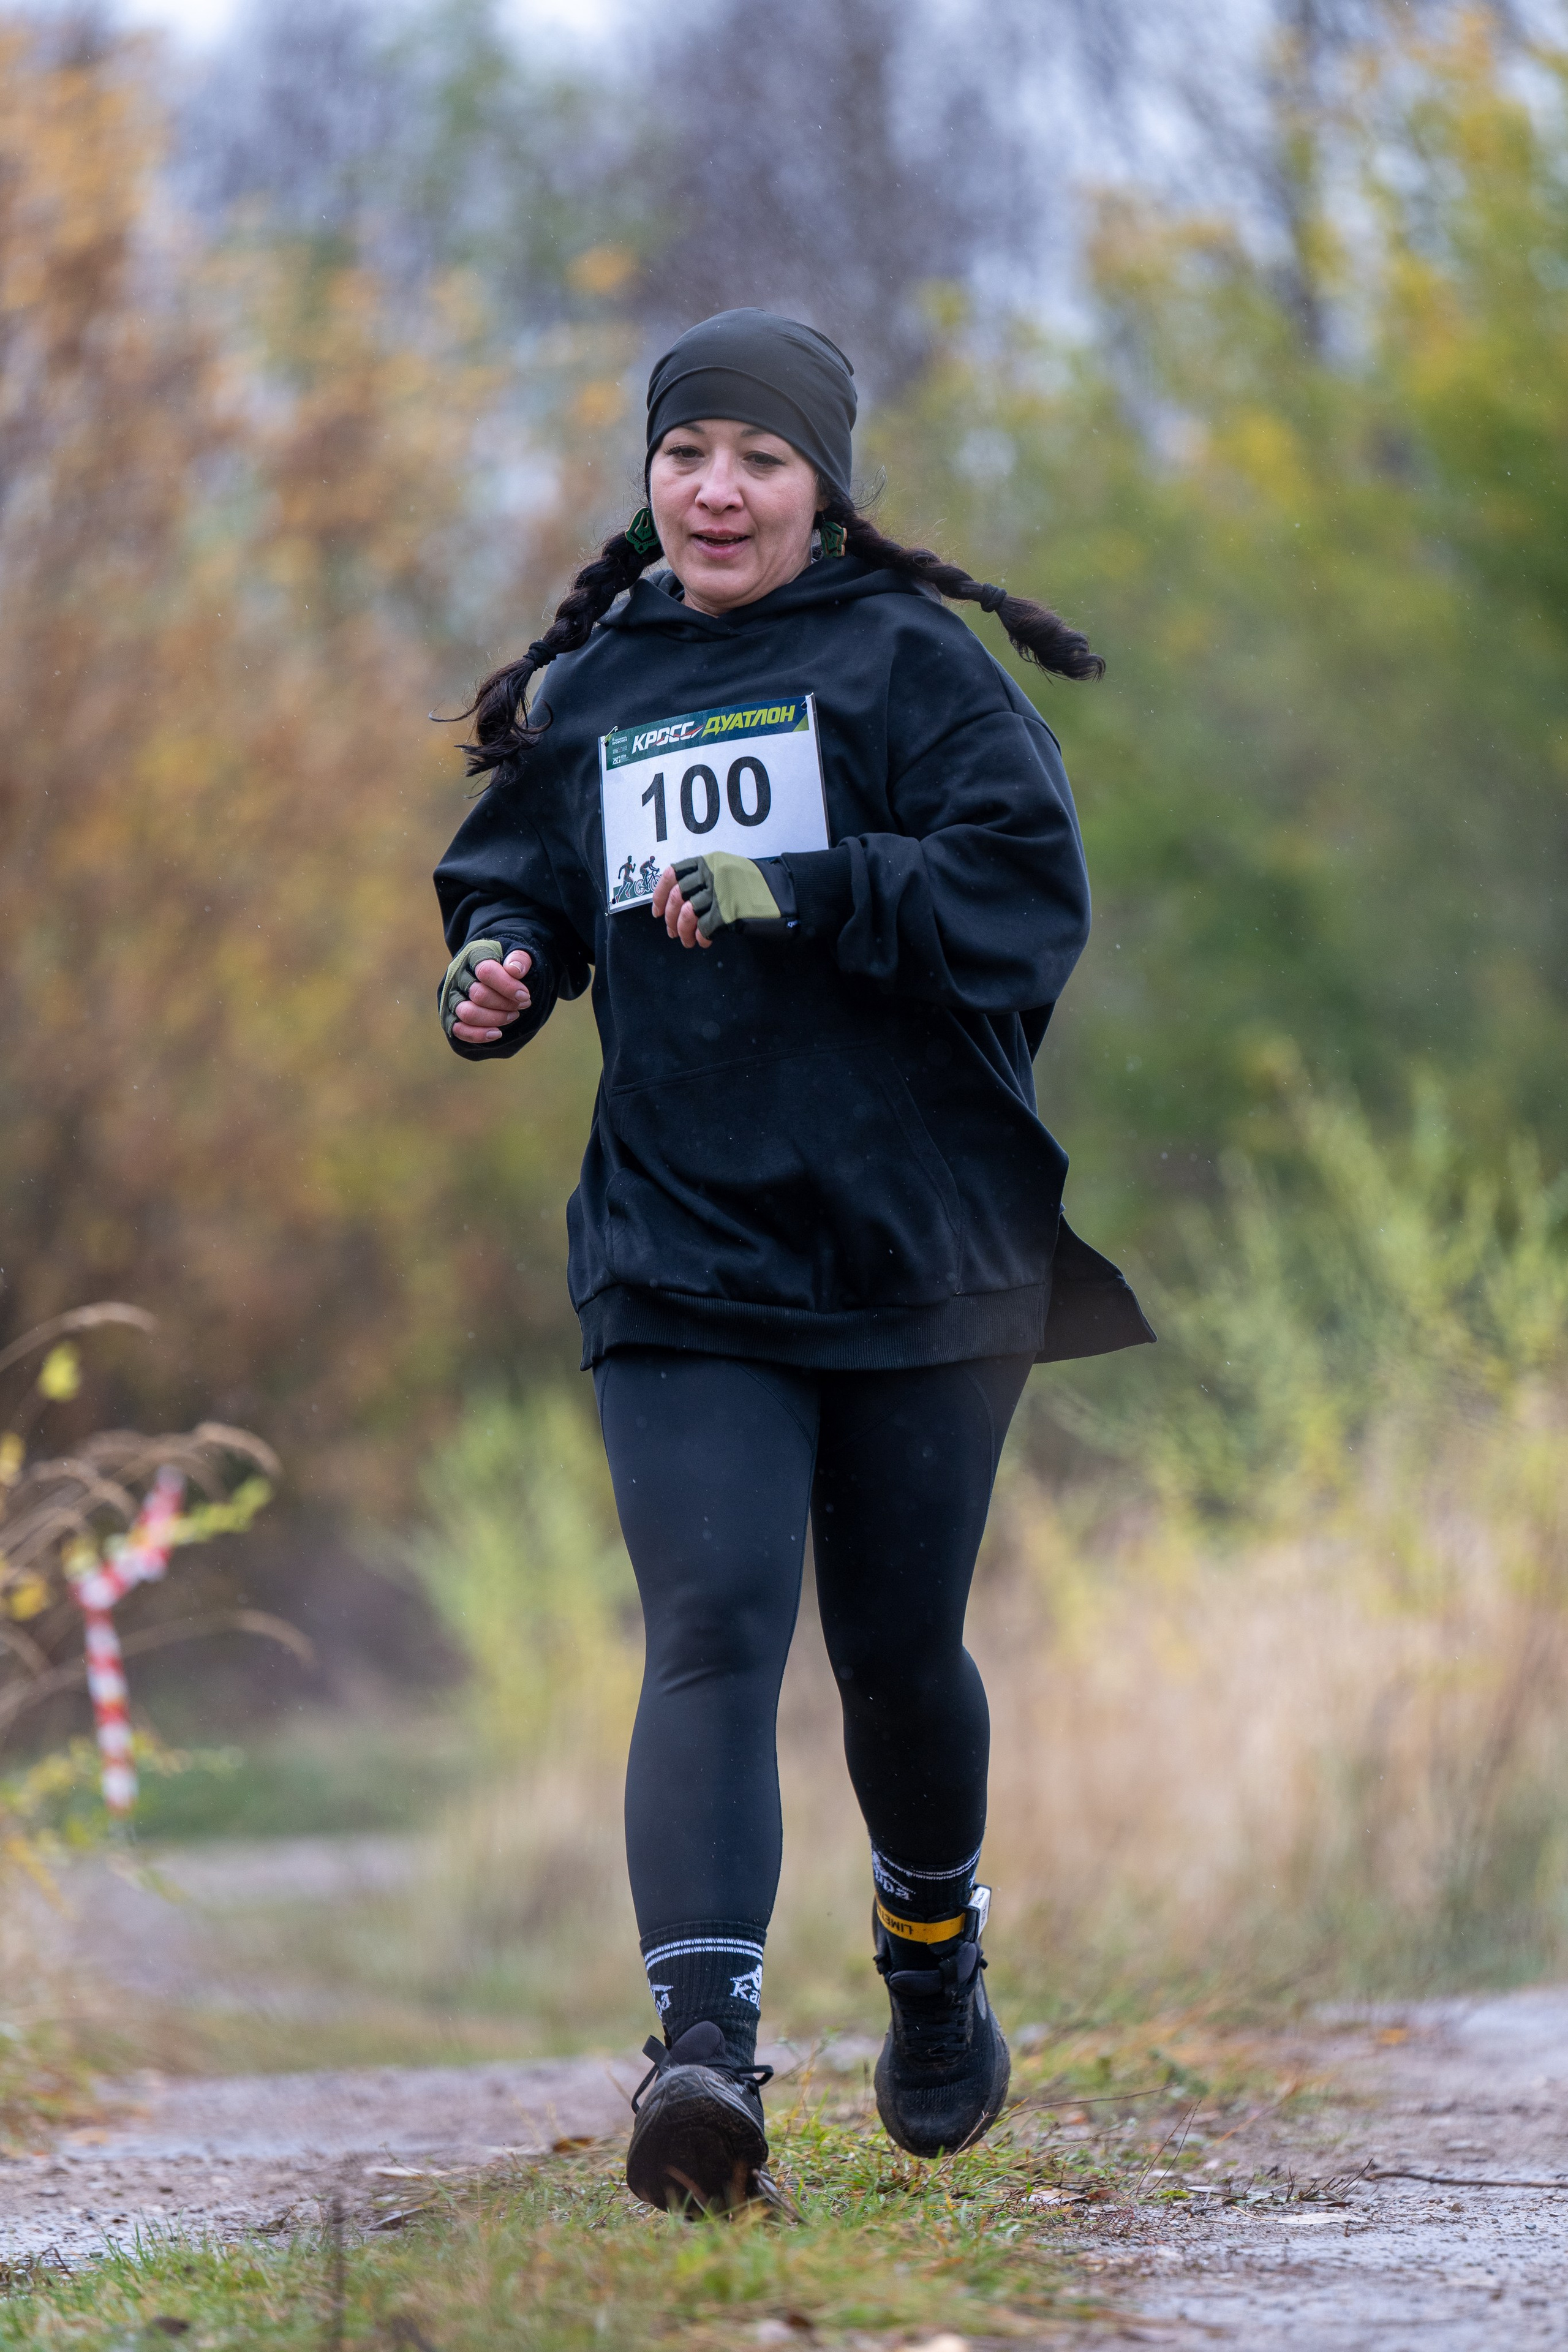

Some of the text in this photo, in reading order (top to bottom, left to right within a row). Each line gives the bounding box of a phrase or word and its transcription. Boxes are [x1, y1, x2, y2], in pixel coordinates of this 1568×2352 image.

[632, 705, 796, 754] КРОСС ДУАТЛОН
[641, 756, 771, 842] 100
